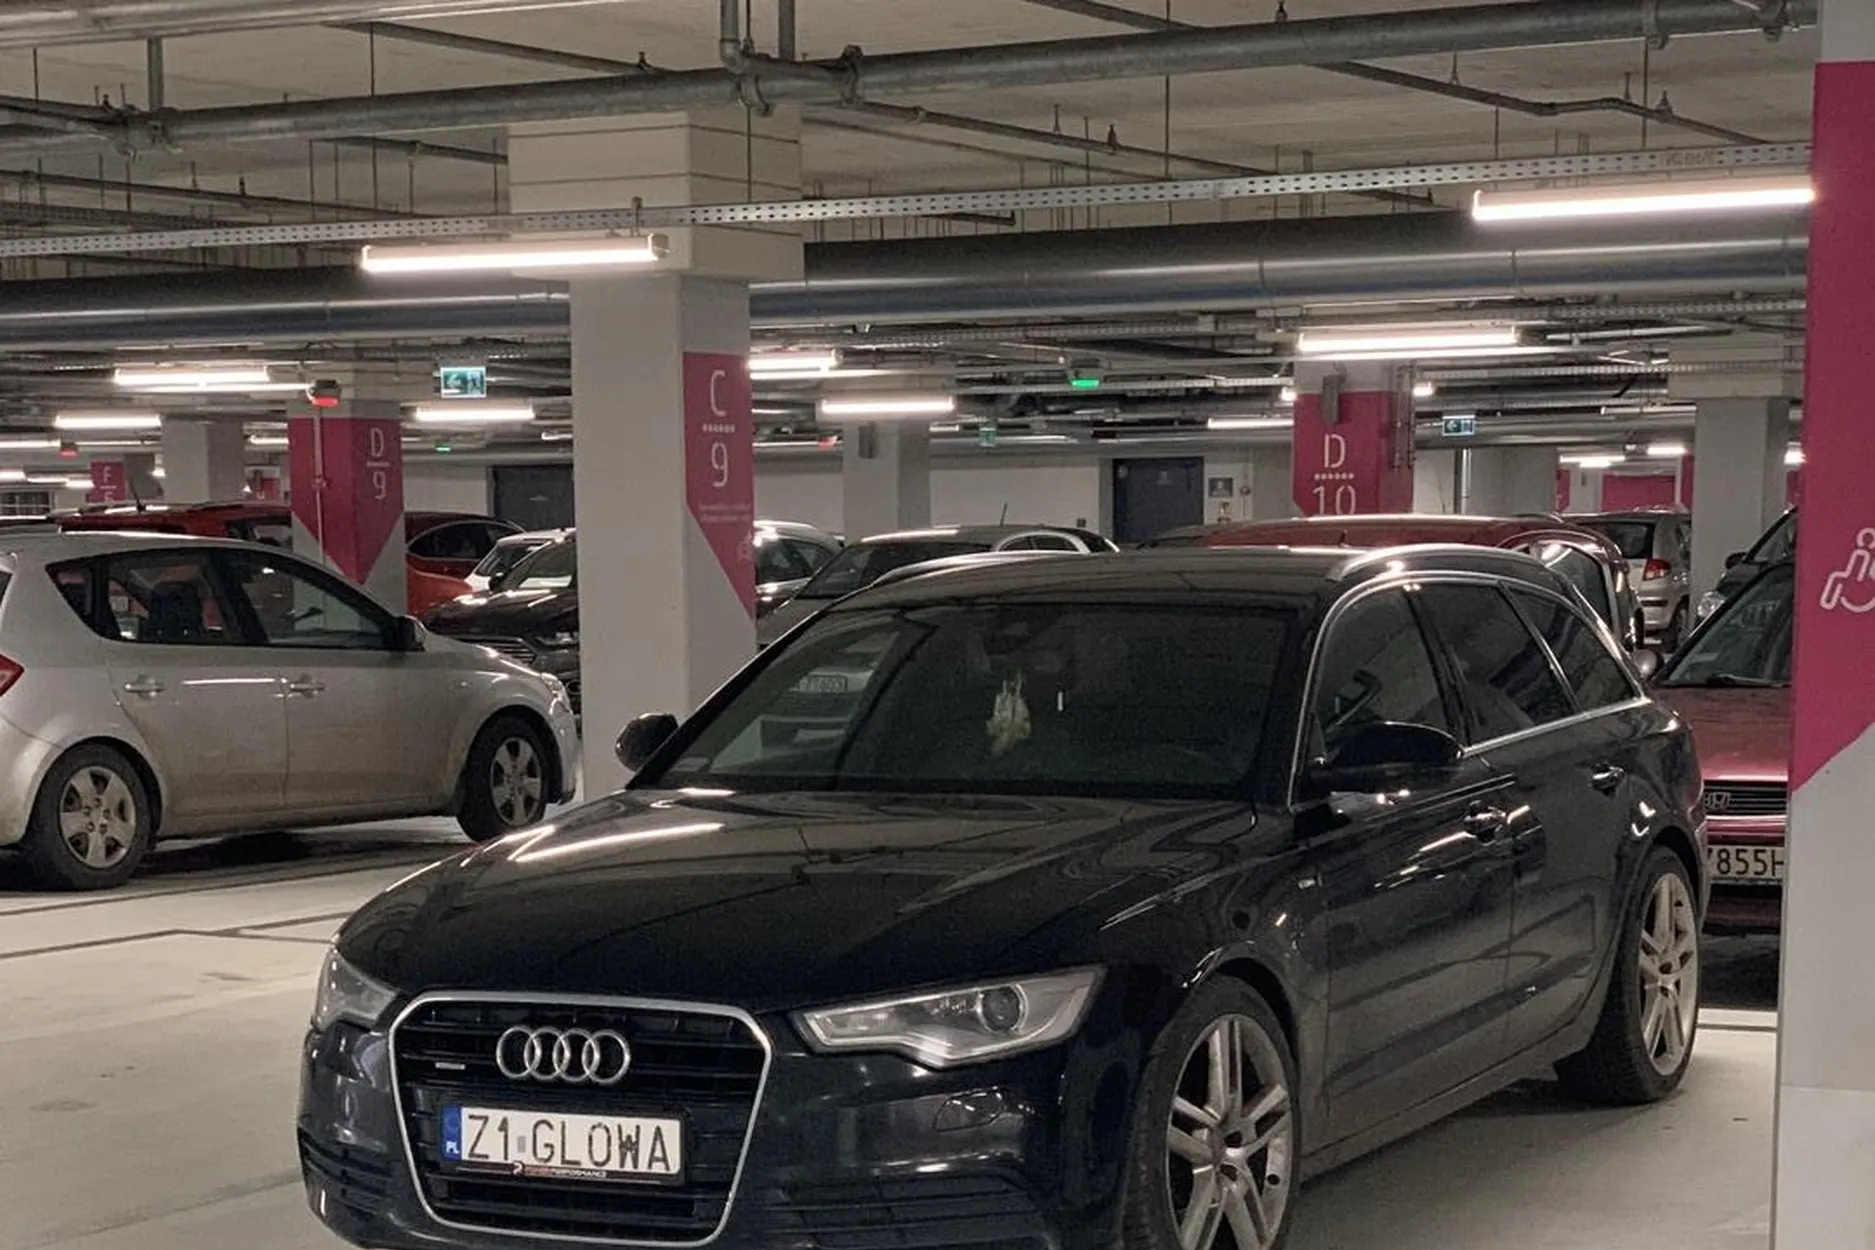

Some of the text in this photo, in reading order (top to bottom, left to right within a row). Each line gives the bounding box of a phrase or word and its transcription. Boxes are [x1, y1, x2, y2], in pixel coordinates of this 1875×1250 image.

[710, 369, 727, 417] C
[370, 427, 385, 458] D
[1324, 432, 1346, 469] D
[711, 442, 729, 488] 9
[372, 470, 386, 500] 9
[1312, 485, 1357, 515] 10
[445, 1140, 460, 1155] PL
[467, 1113, 671, 1172] Z1 GLOWA
